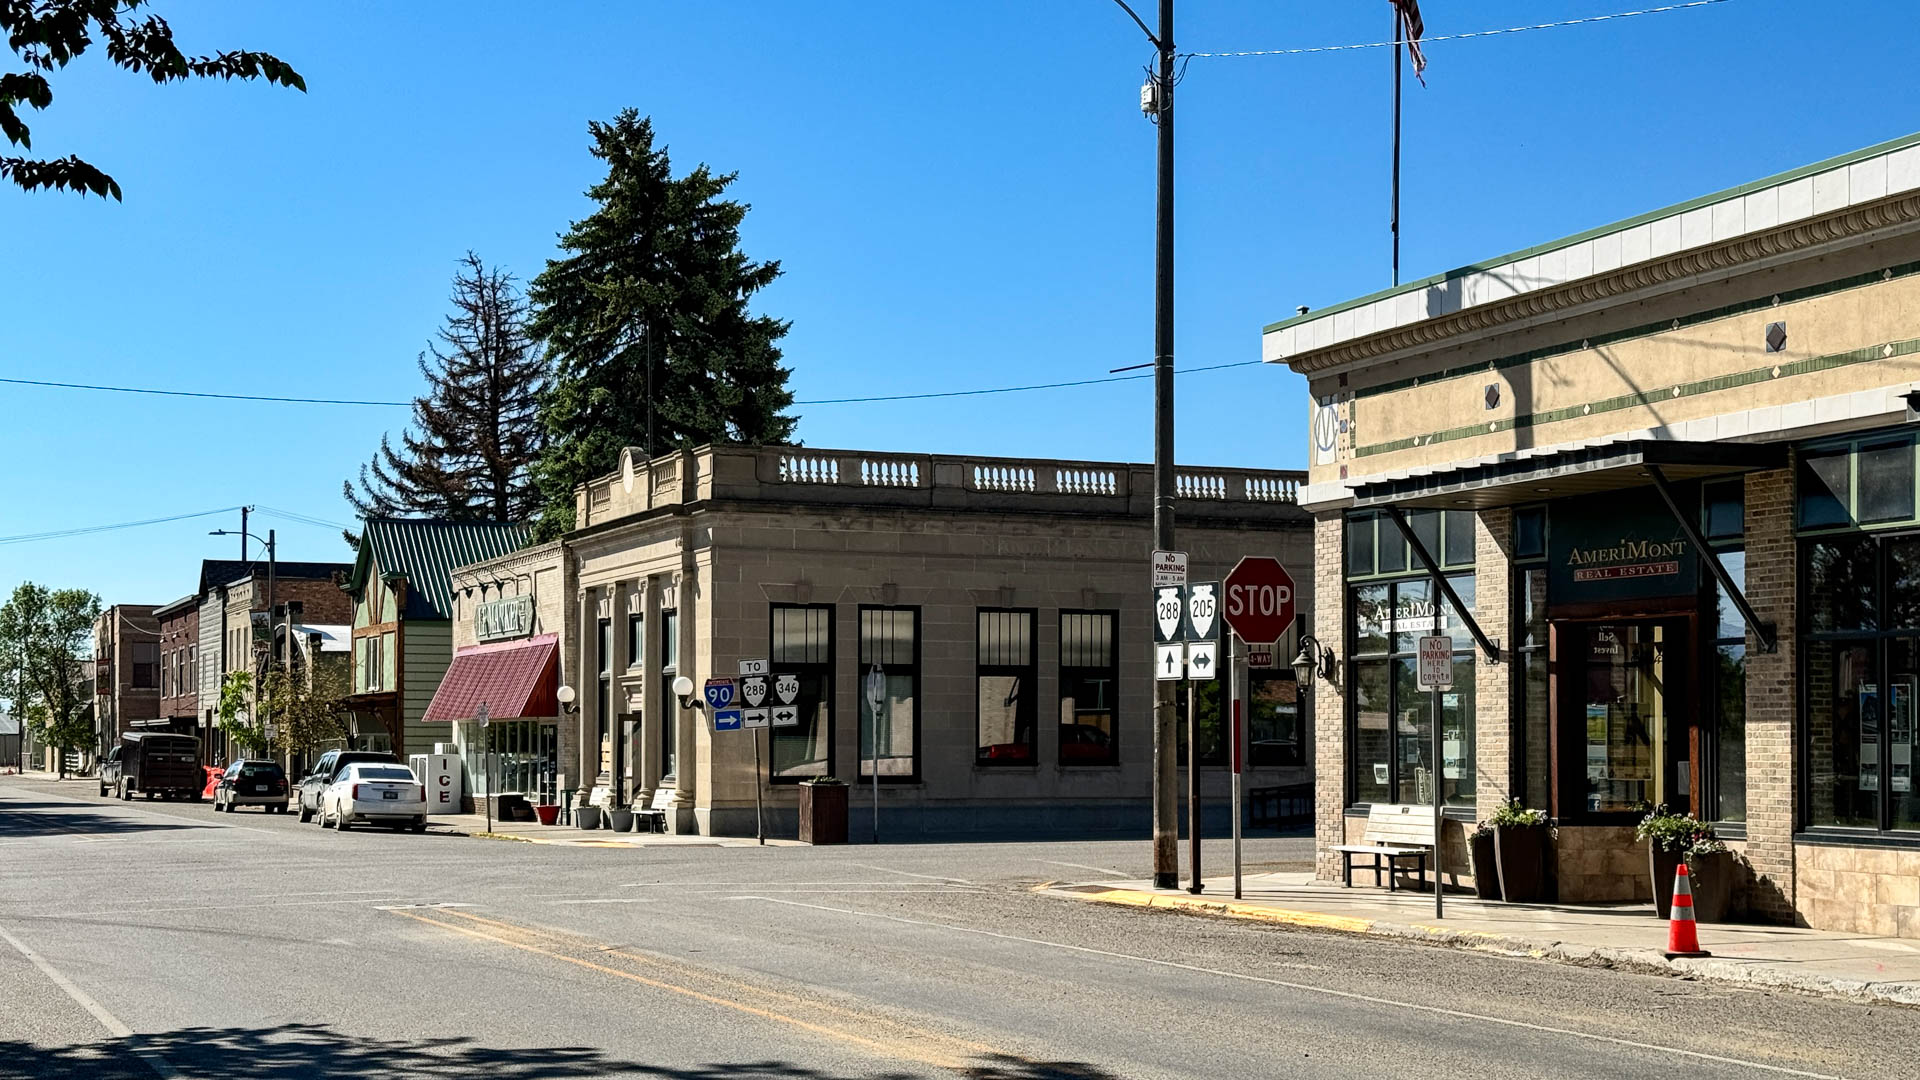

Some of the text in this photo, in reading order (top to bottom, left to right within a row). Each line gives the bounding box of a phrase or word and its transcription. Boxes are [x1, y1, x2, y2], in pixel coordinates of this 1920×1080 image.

[1165, 554, 1176, 563] NO
[1567, 538, 1687, 566] AMERIMONT
[1155, 563, 1185, 572] PARKING
[1576, 563, 1675, 580] REAL ESTATE
[1228, 584, 1291, 616] STOP
[1159, 602, 1179, 620] 288
[1192, 599, 1213, 618] 205
[1429, 641, 1442, 650] NO
[1422, 651, 1450, 660] PARKING
[746, 662, 761, 672] TO
[708, 687, 730, 703] 90
[745, 684, 765, 697] 288
[778, 682, 797, 694] 346
[438, 758, 451, 803] ICE
